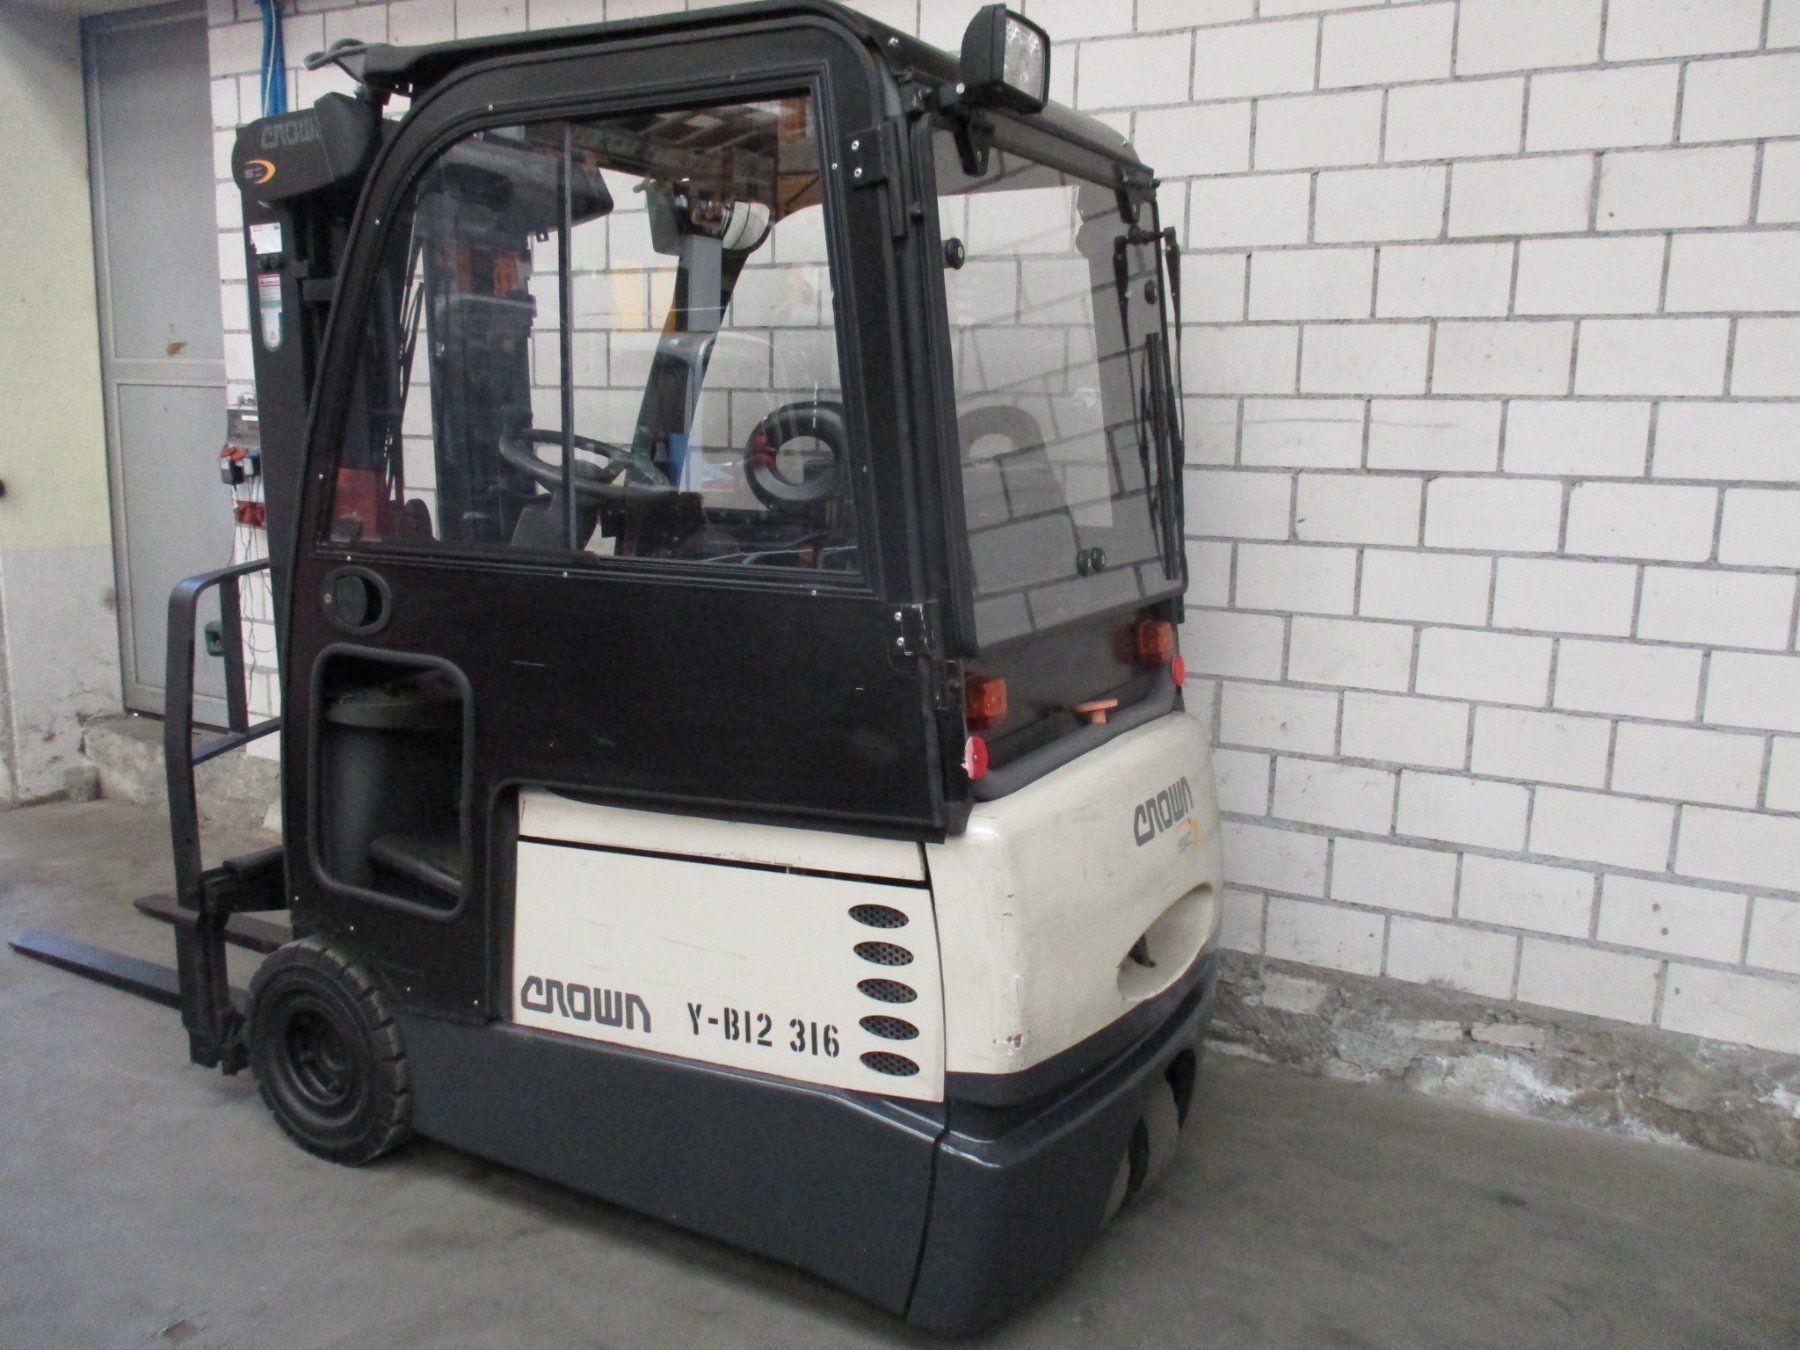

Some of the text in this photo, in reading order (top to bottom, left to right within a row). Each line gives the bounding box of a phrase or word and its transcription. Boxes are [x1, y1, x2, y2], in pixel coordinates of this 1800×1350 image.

[1133, 776, 1194, 847] CROWN
[521, 975, 652, 1034] CROWN
[687, 1002, 840, 1058] Y-B12 316
